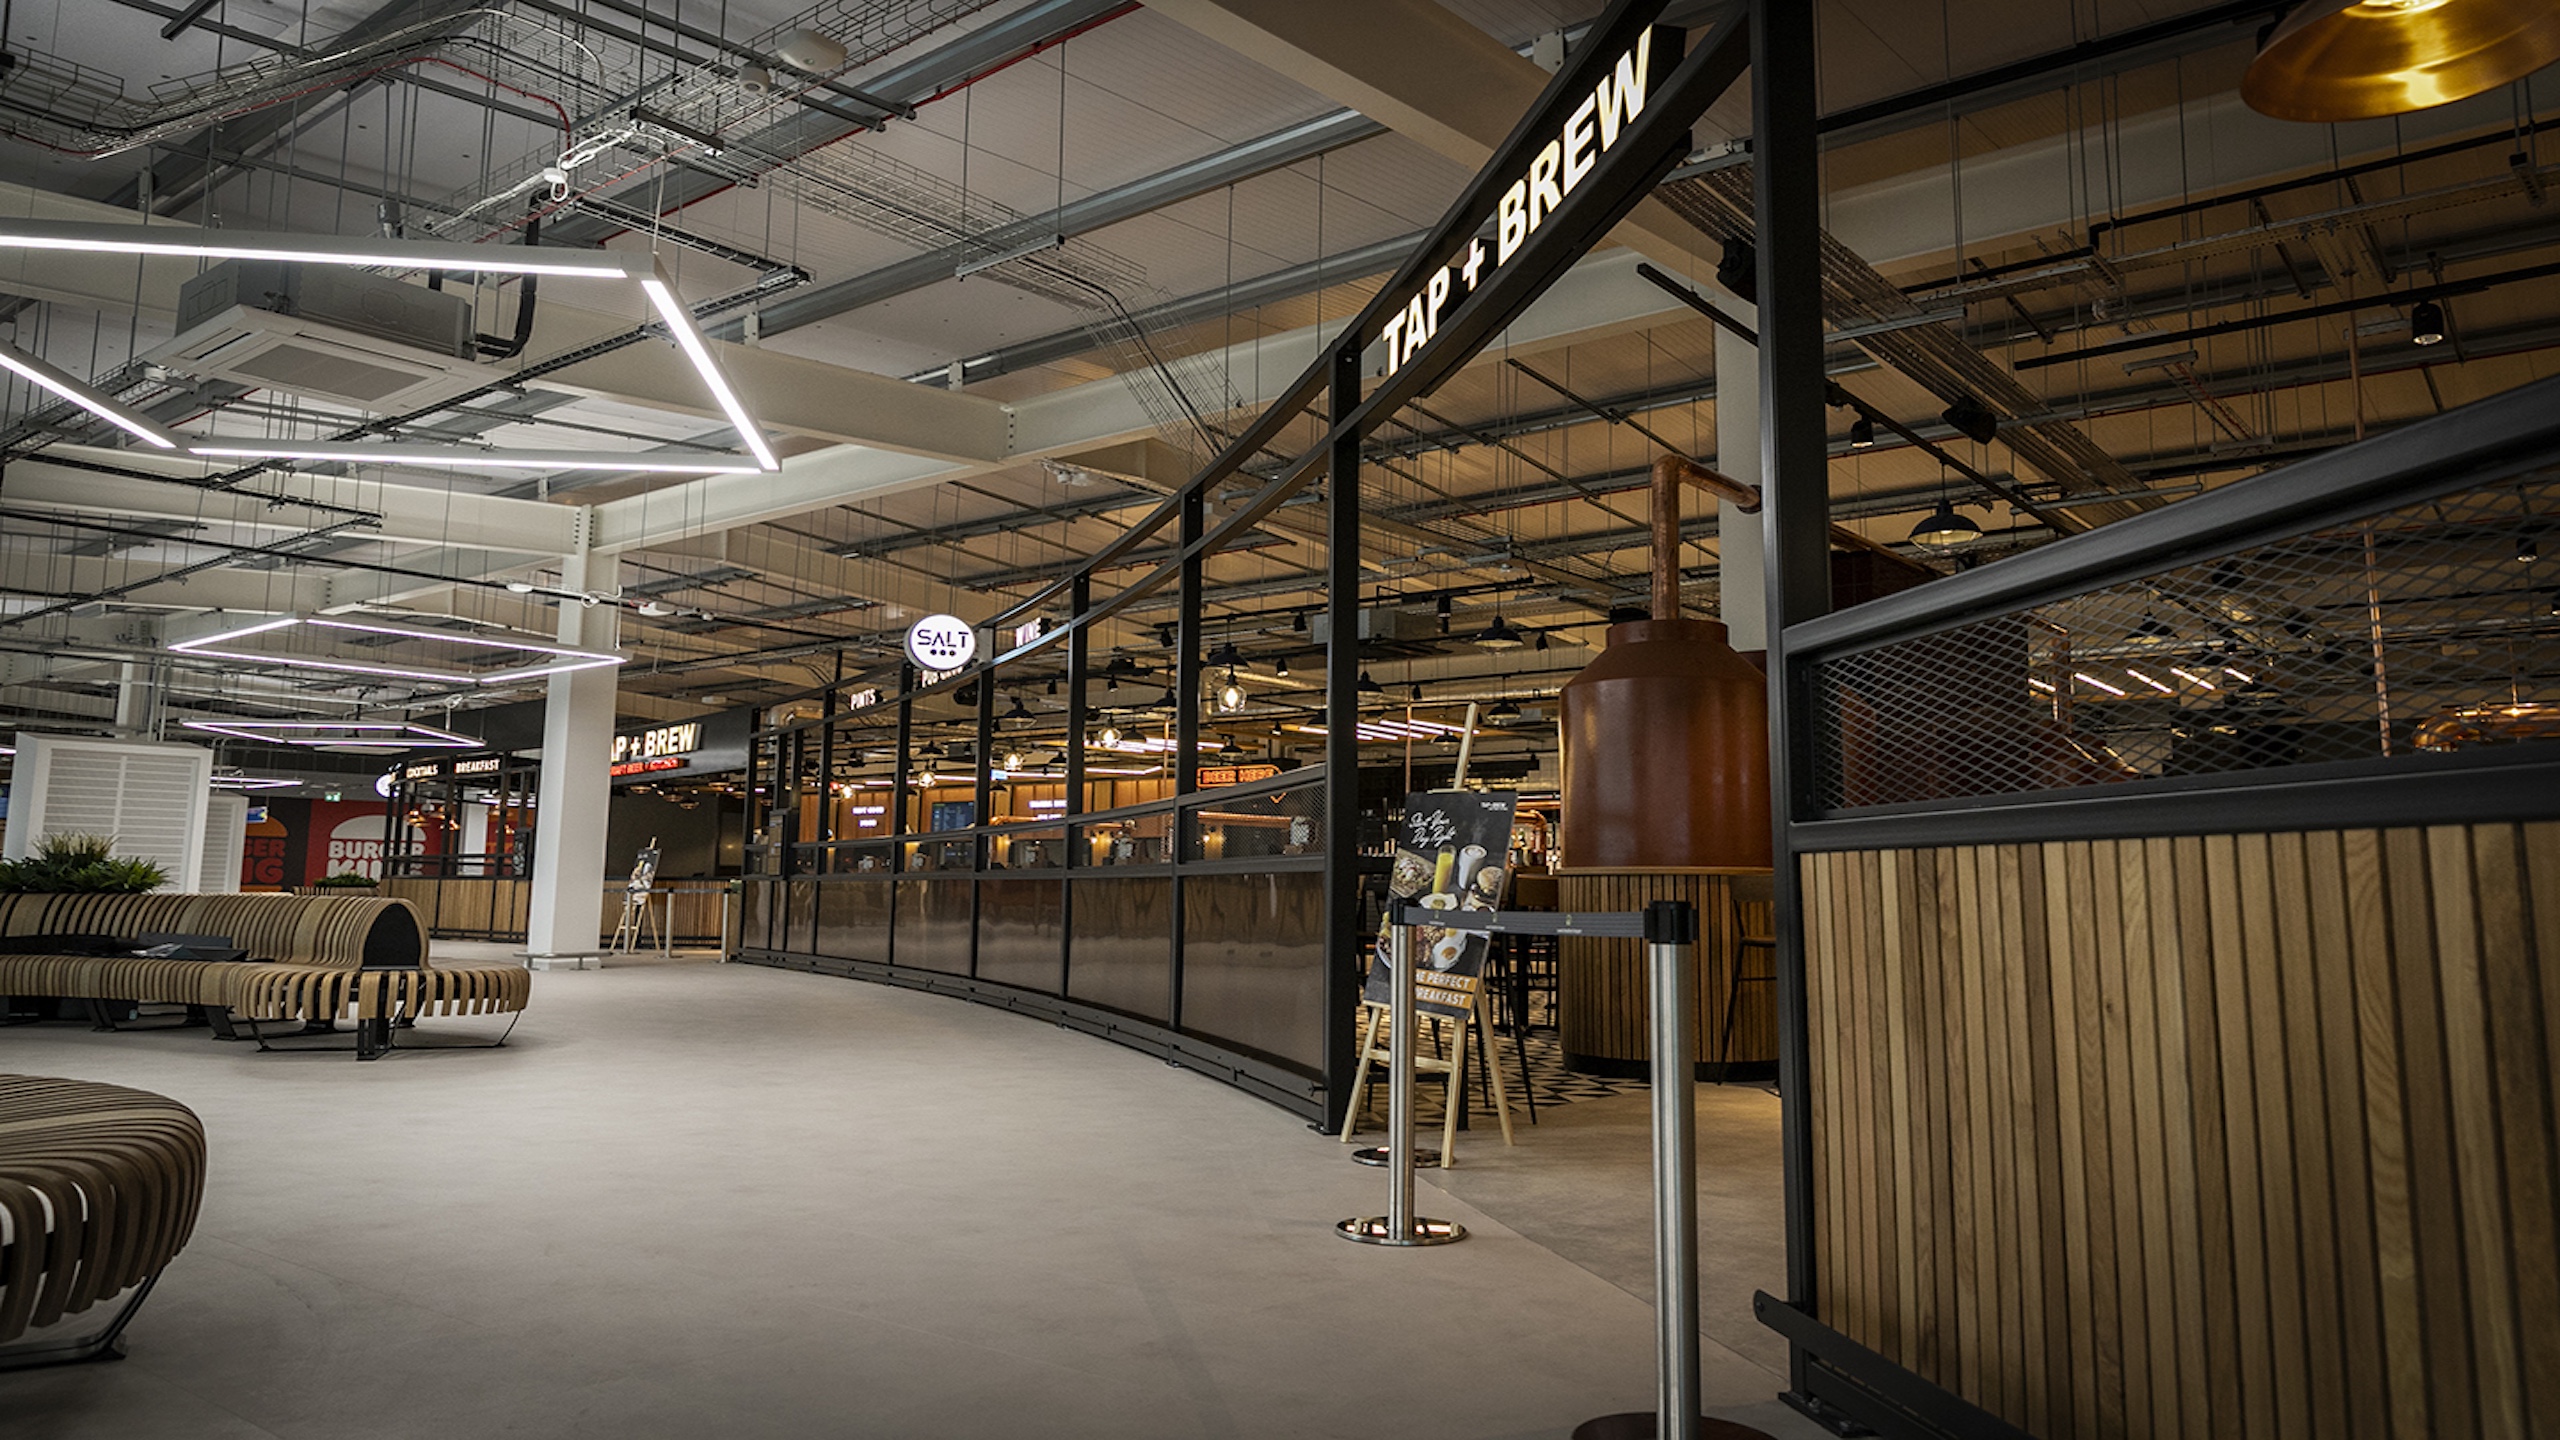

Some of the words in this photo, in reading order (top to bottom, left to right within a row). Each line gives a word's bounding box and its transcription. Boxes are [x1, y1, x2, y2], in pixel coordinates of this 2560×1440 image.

[1382, 264, 1450, 377] TAP
[1461, 236, 1486, 292] +
[1498, 23, 1653, 268] BREW
[917, 629, 969, 649] SALT
[850, 688, 876, 711] PINTS
[644, 722, 697, 758] BREW
[455, 759, 500, 775] BREAKFAST
[1202, 770, 1237, 784] BEER
[1426, 973, 1471, 989] PERFECT
